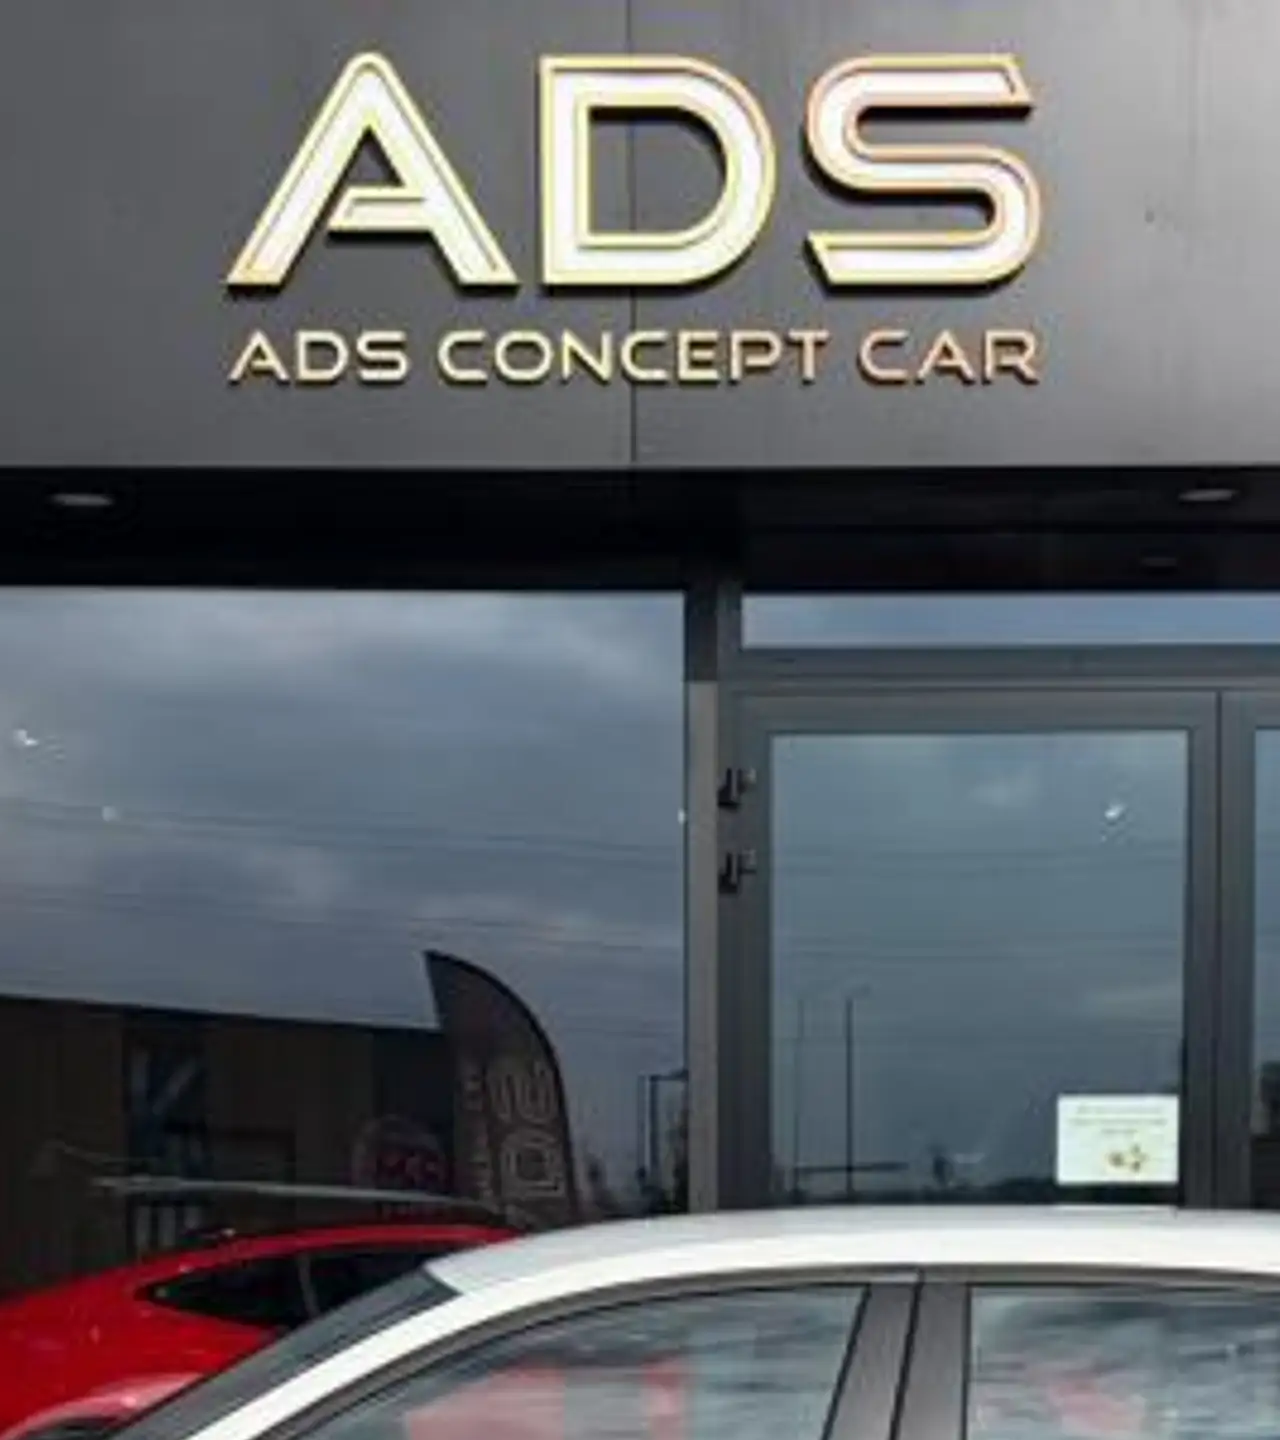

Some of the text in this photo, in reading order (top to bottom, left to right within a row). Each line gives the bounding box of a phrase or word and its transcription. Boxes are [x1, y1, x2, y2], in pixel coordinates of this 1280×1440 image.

[227, 51, 1042, 286] ADS
[229, 330, 1040, 385] ADS CONCEPT CAR
